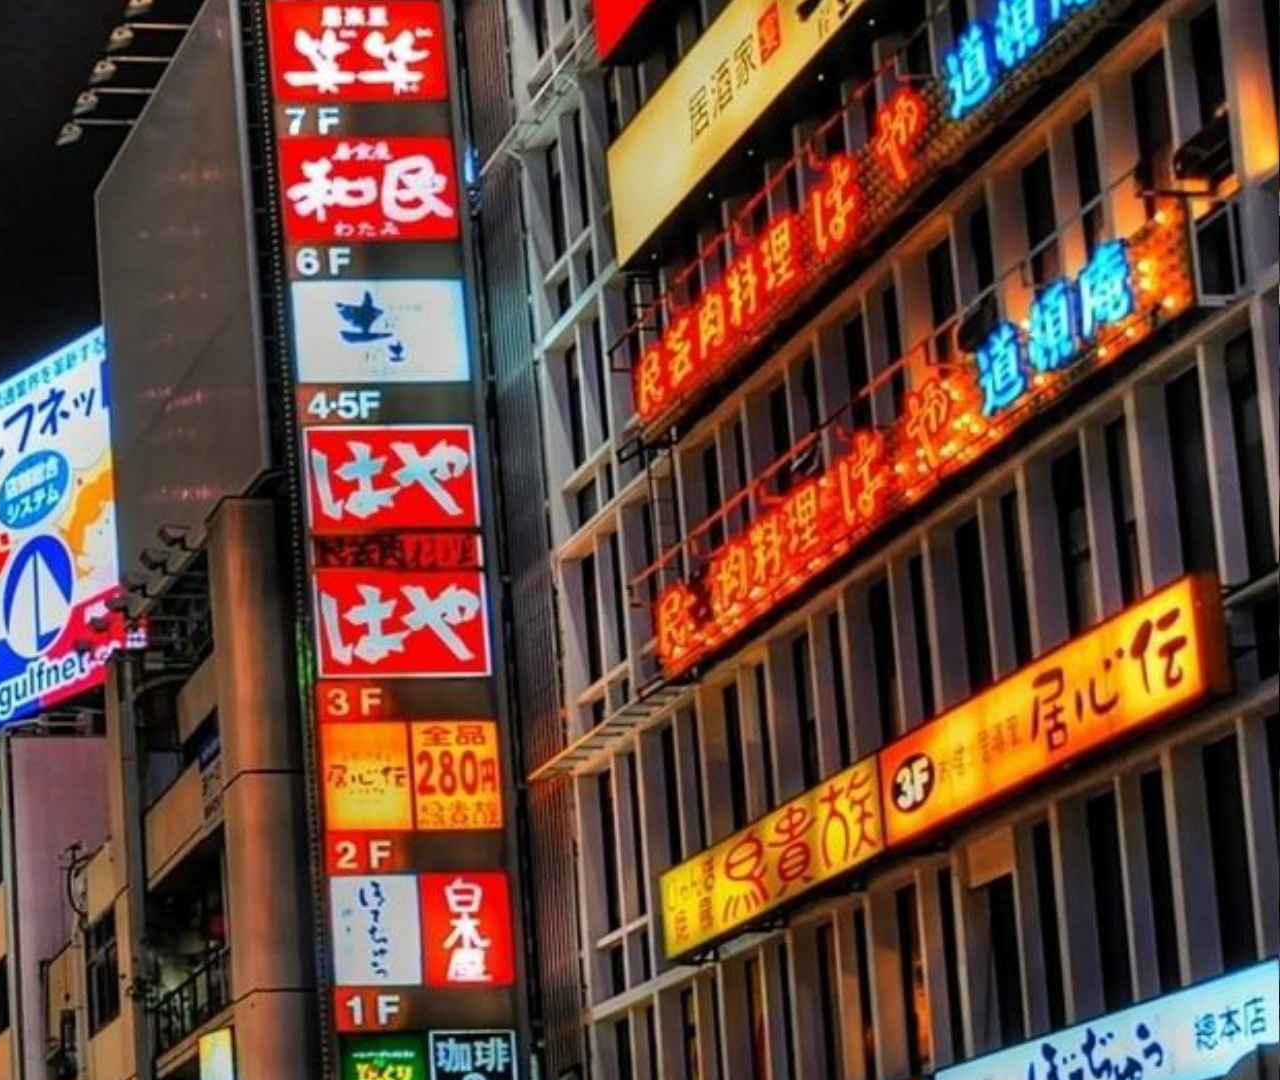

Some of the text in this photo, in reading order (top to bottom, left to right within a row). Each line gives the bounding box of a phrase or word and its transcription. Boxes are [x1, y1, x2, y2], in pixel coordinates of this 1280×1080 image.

[286, 155, 454, 223] 和民
[332, 220, 401, 238] わたみ
[420, 724, 486, 747] 全品
[415, 749, 497, 797] 280円
[895, 754, 930, 810] 3F
[724, 771, 878, 923] 鳥貴族
[442, 877, 493, 983] 白木屋
[435, 1036, 510, 1073] 珈琲
